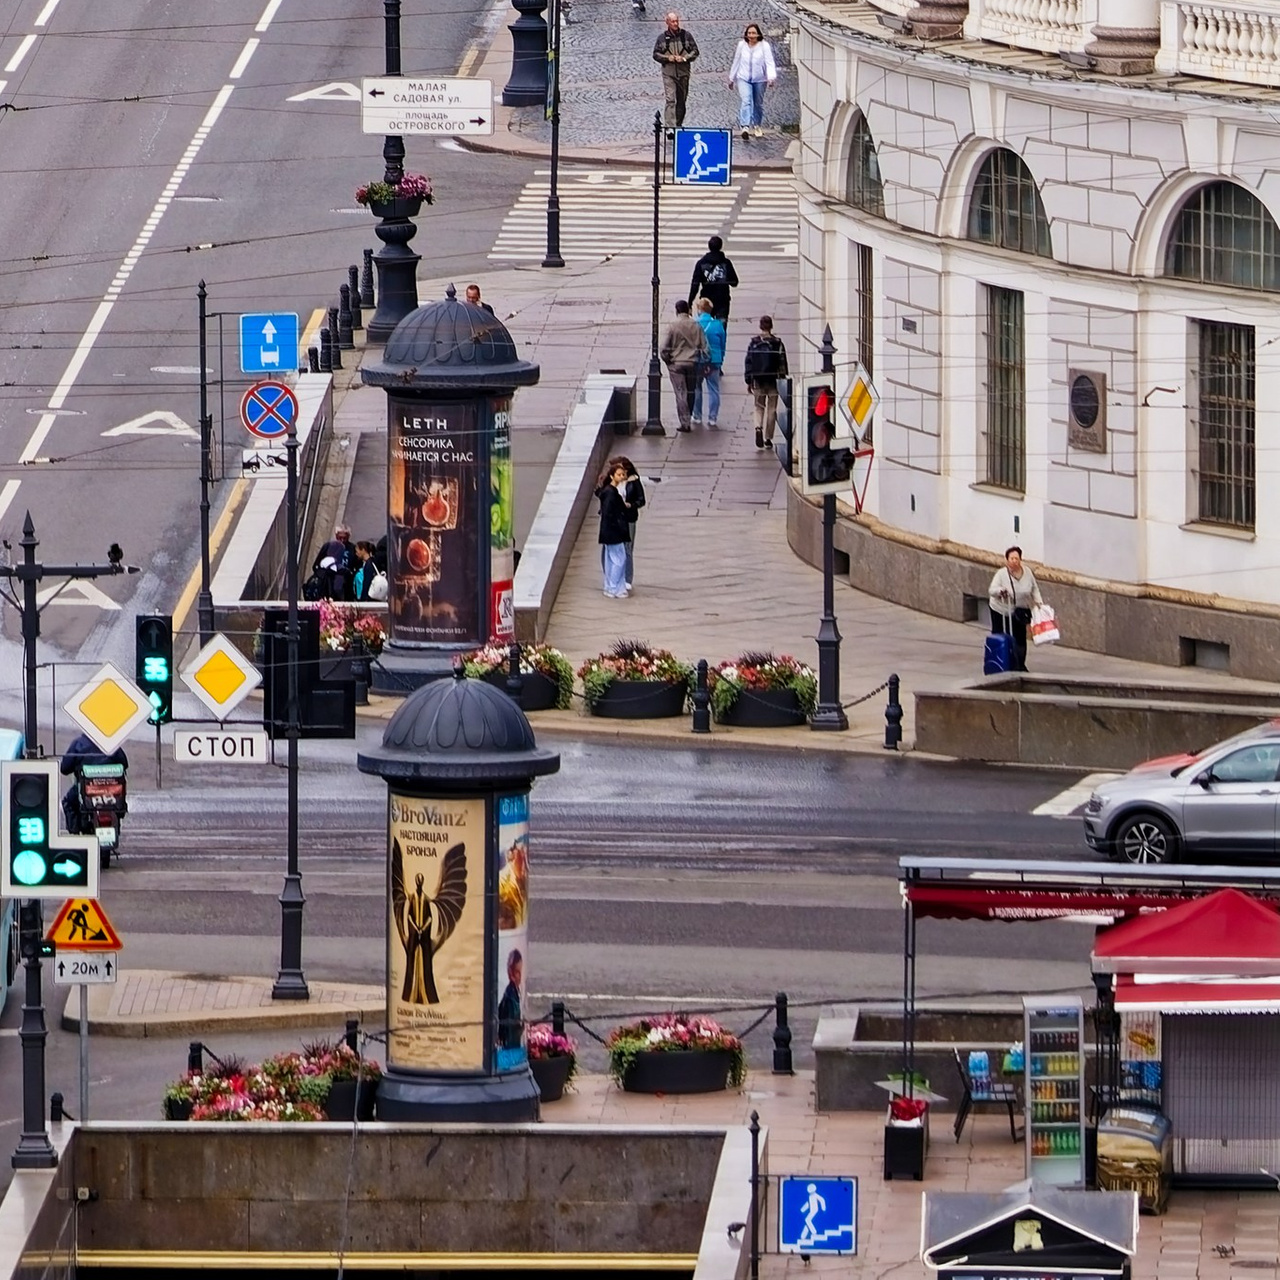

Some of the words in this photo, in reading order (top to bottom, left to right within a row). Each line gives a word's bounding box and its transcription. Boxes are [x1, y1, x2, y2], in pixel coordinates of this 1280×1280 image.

[408, 83, 447, 93] МАЛАЯ
[393, 94, 444, 105] САДОВАЯ
[448, 96, 462, 105] ул.
[405, 111, 448, 121] площадь
[388, 121, 465, 131] ОСТРОВСКОГО
[403, 416, 448, 430] LETH
[398, 436, 455, 449] СЕНСОРИКА
[441, 452, 450, 462] С
[451, 452, 474, 462] НАС
[187, 736, 254, 758] СТОП
[401, 806, 466, 827] BroVanz
[399, 829, 449, 844] НАСТОЯЩАЯ
[406, 845, 438, 858] БРОНЗА
[71, 962, 99, 975] 20м
